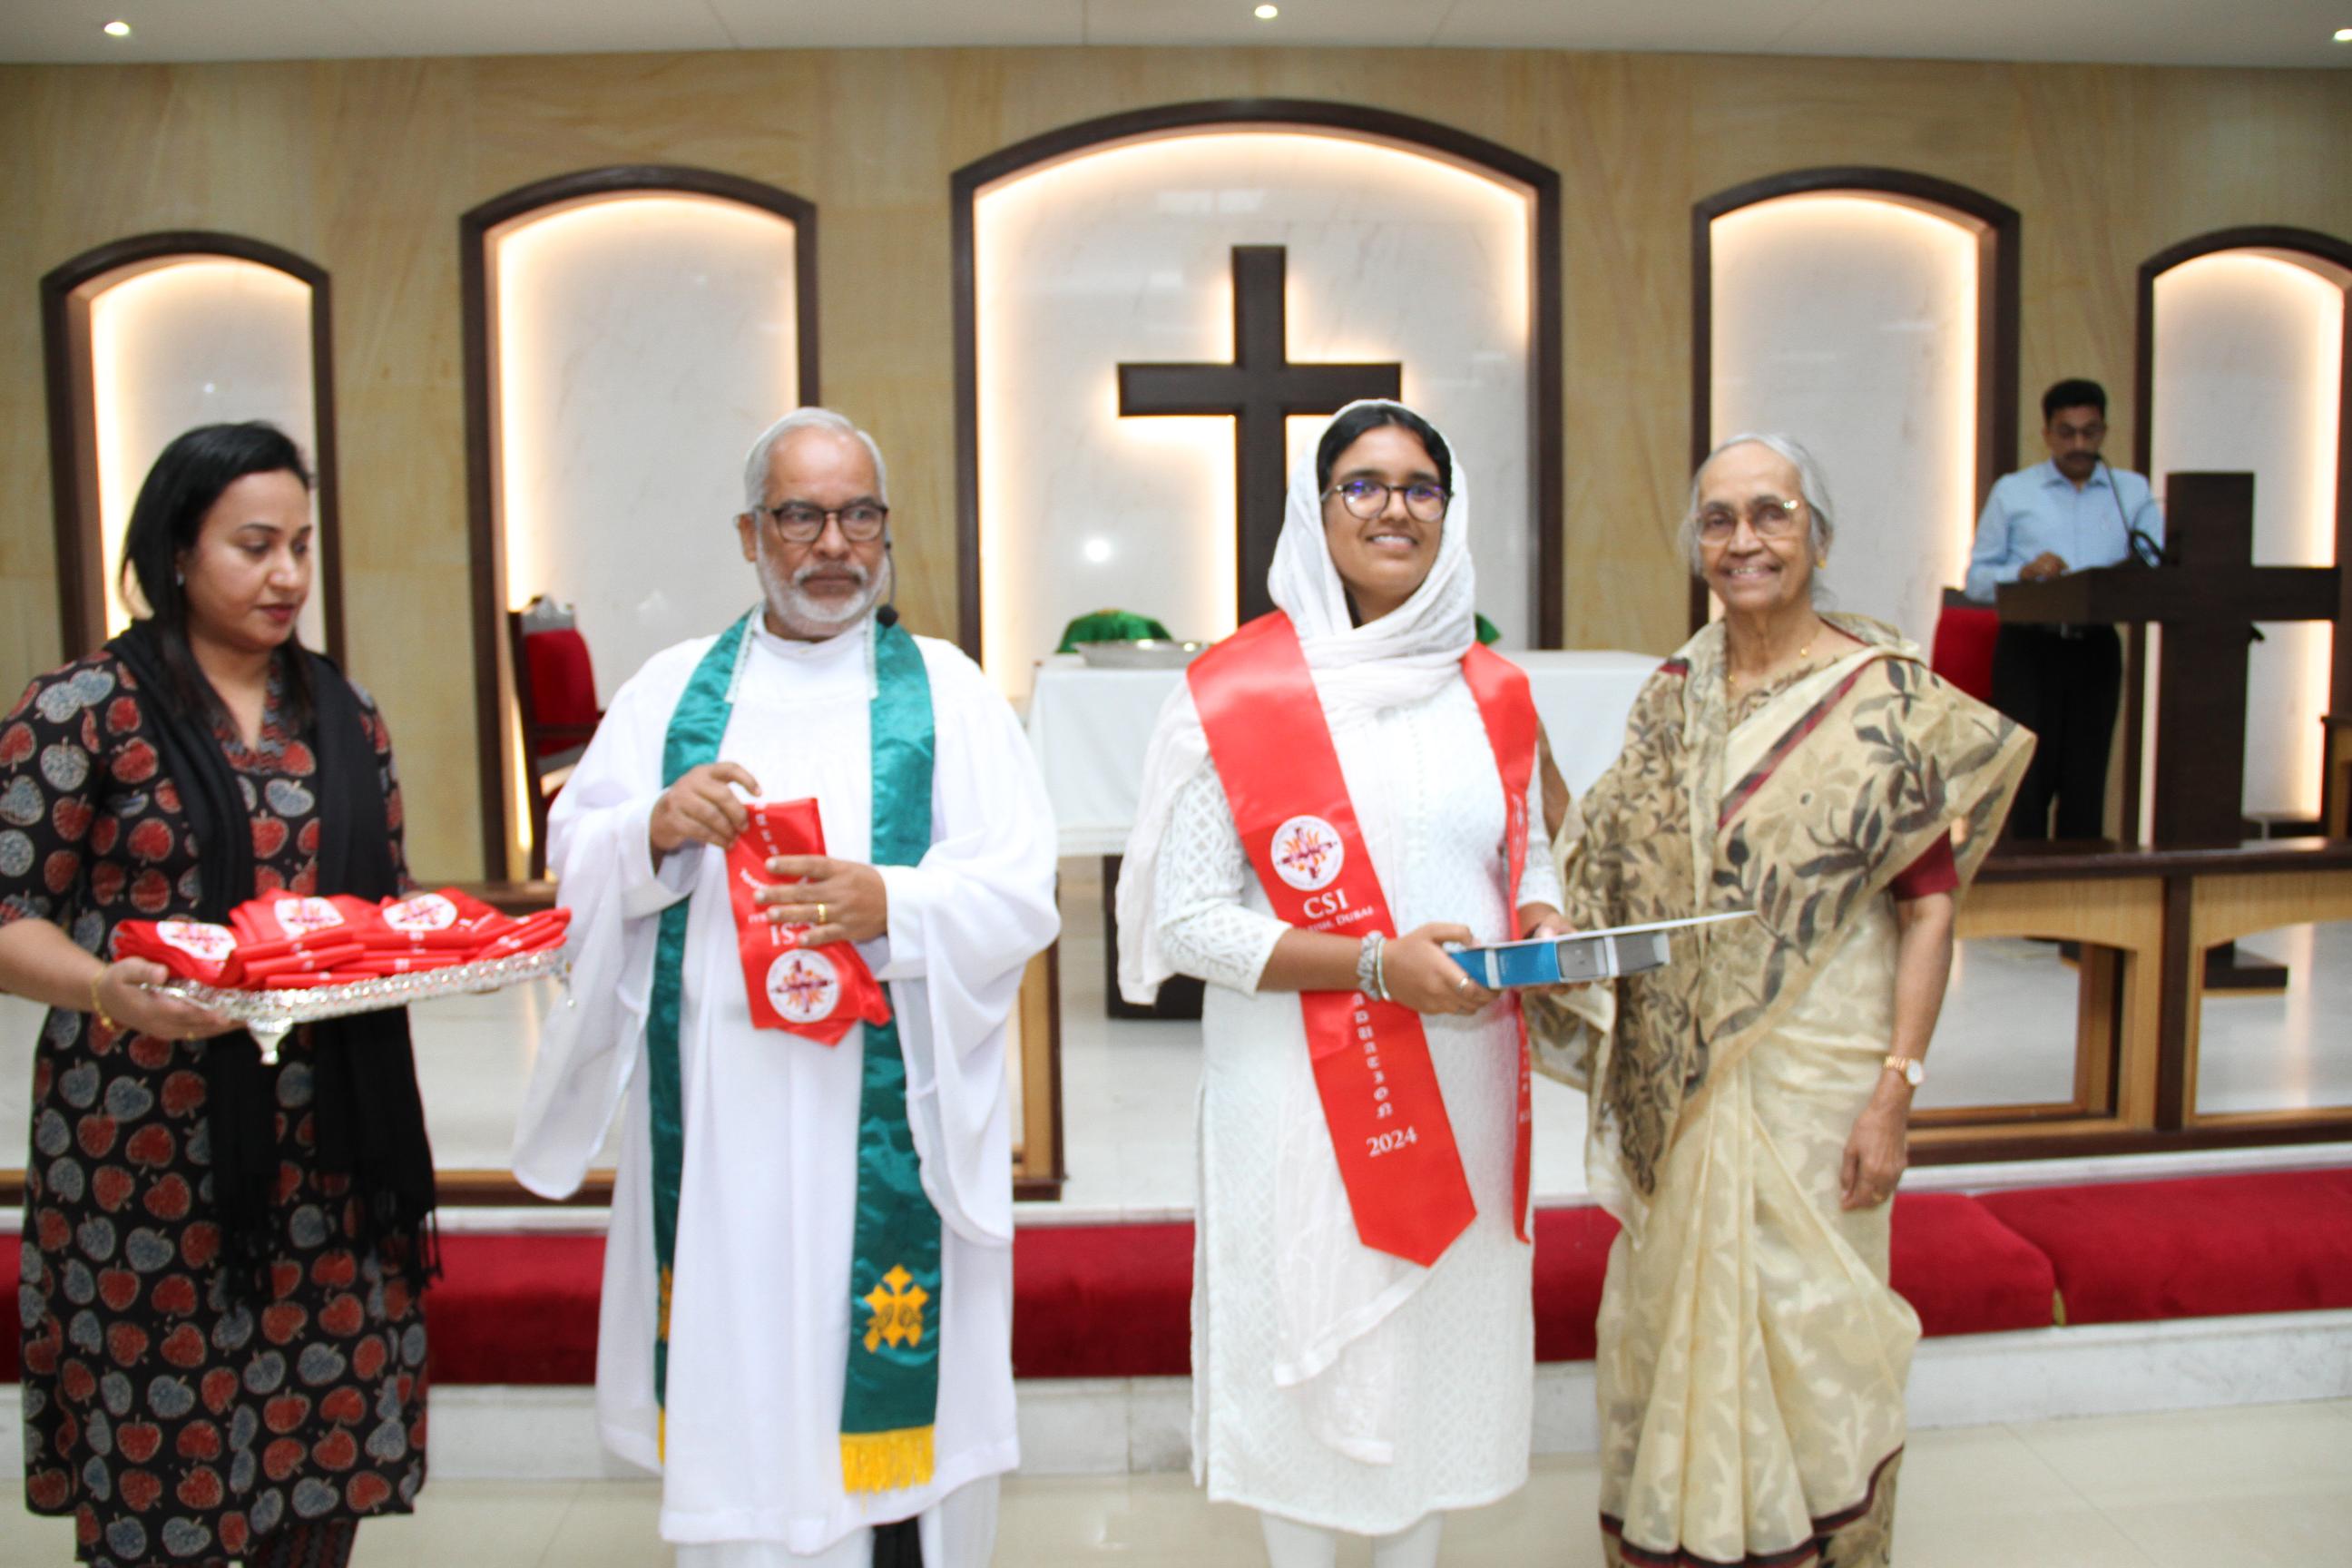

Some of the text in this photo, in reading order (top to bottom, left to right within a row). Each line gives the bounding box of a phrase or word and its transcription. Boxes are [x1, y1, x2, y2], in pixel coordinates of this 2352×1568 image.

[1303, 888, 1349, 919] CSI
[1336, 906, 1375, 926] DUBAI
[1366, 1125, 1418, 1157] 2024
